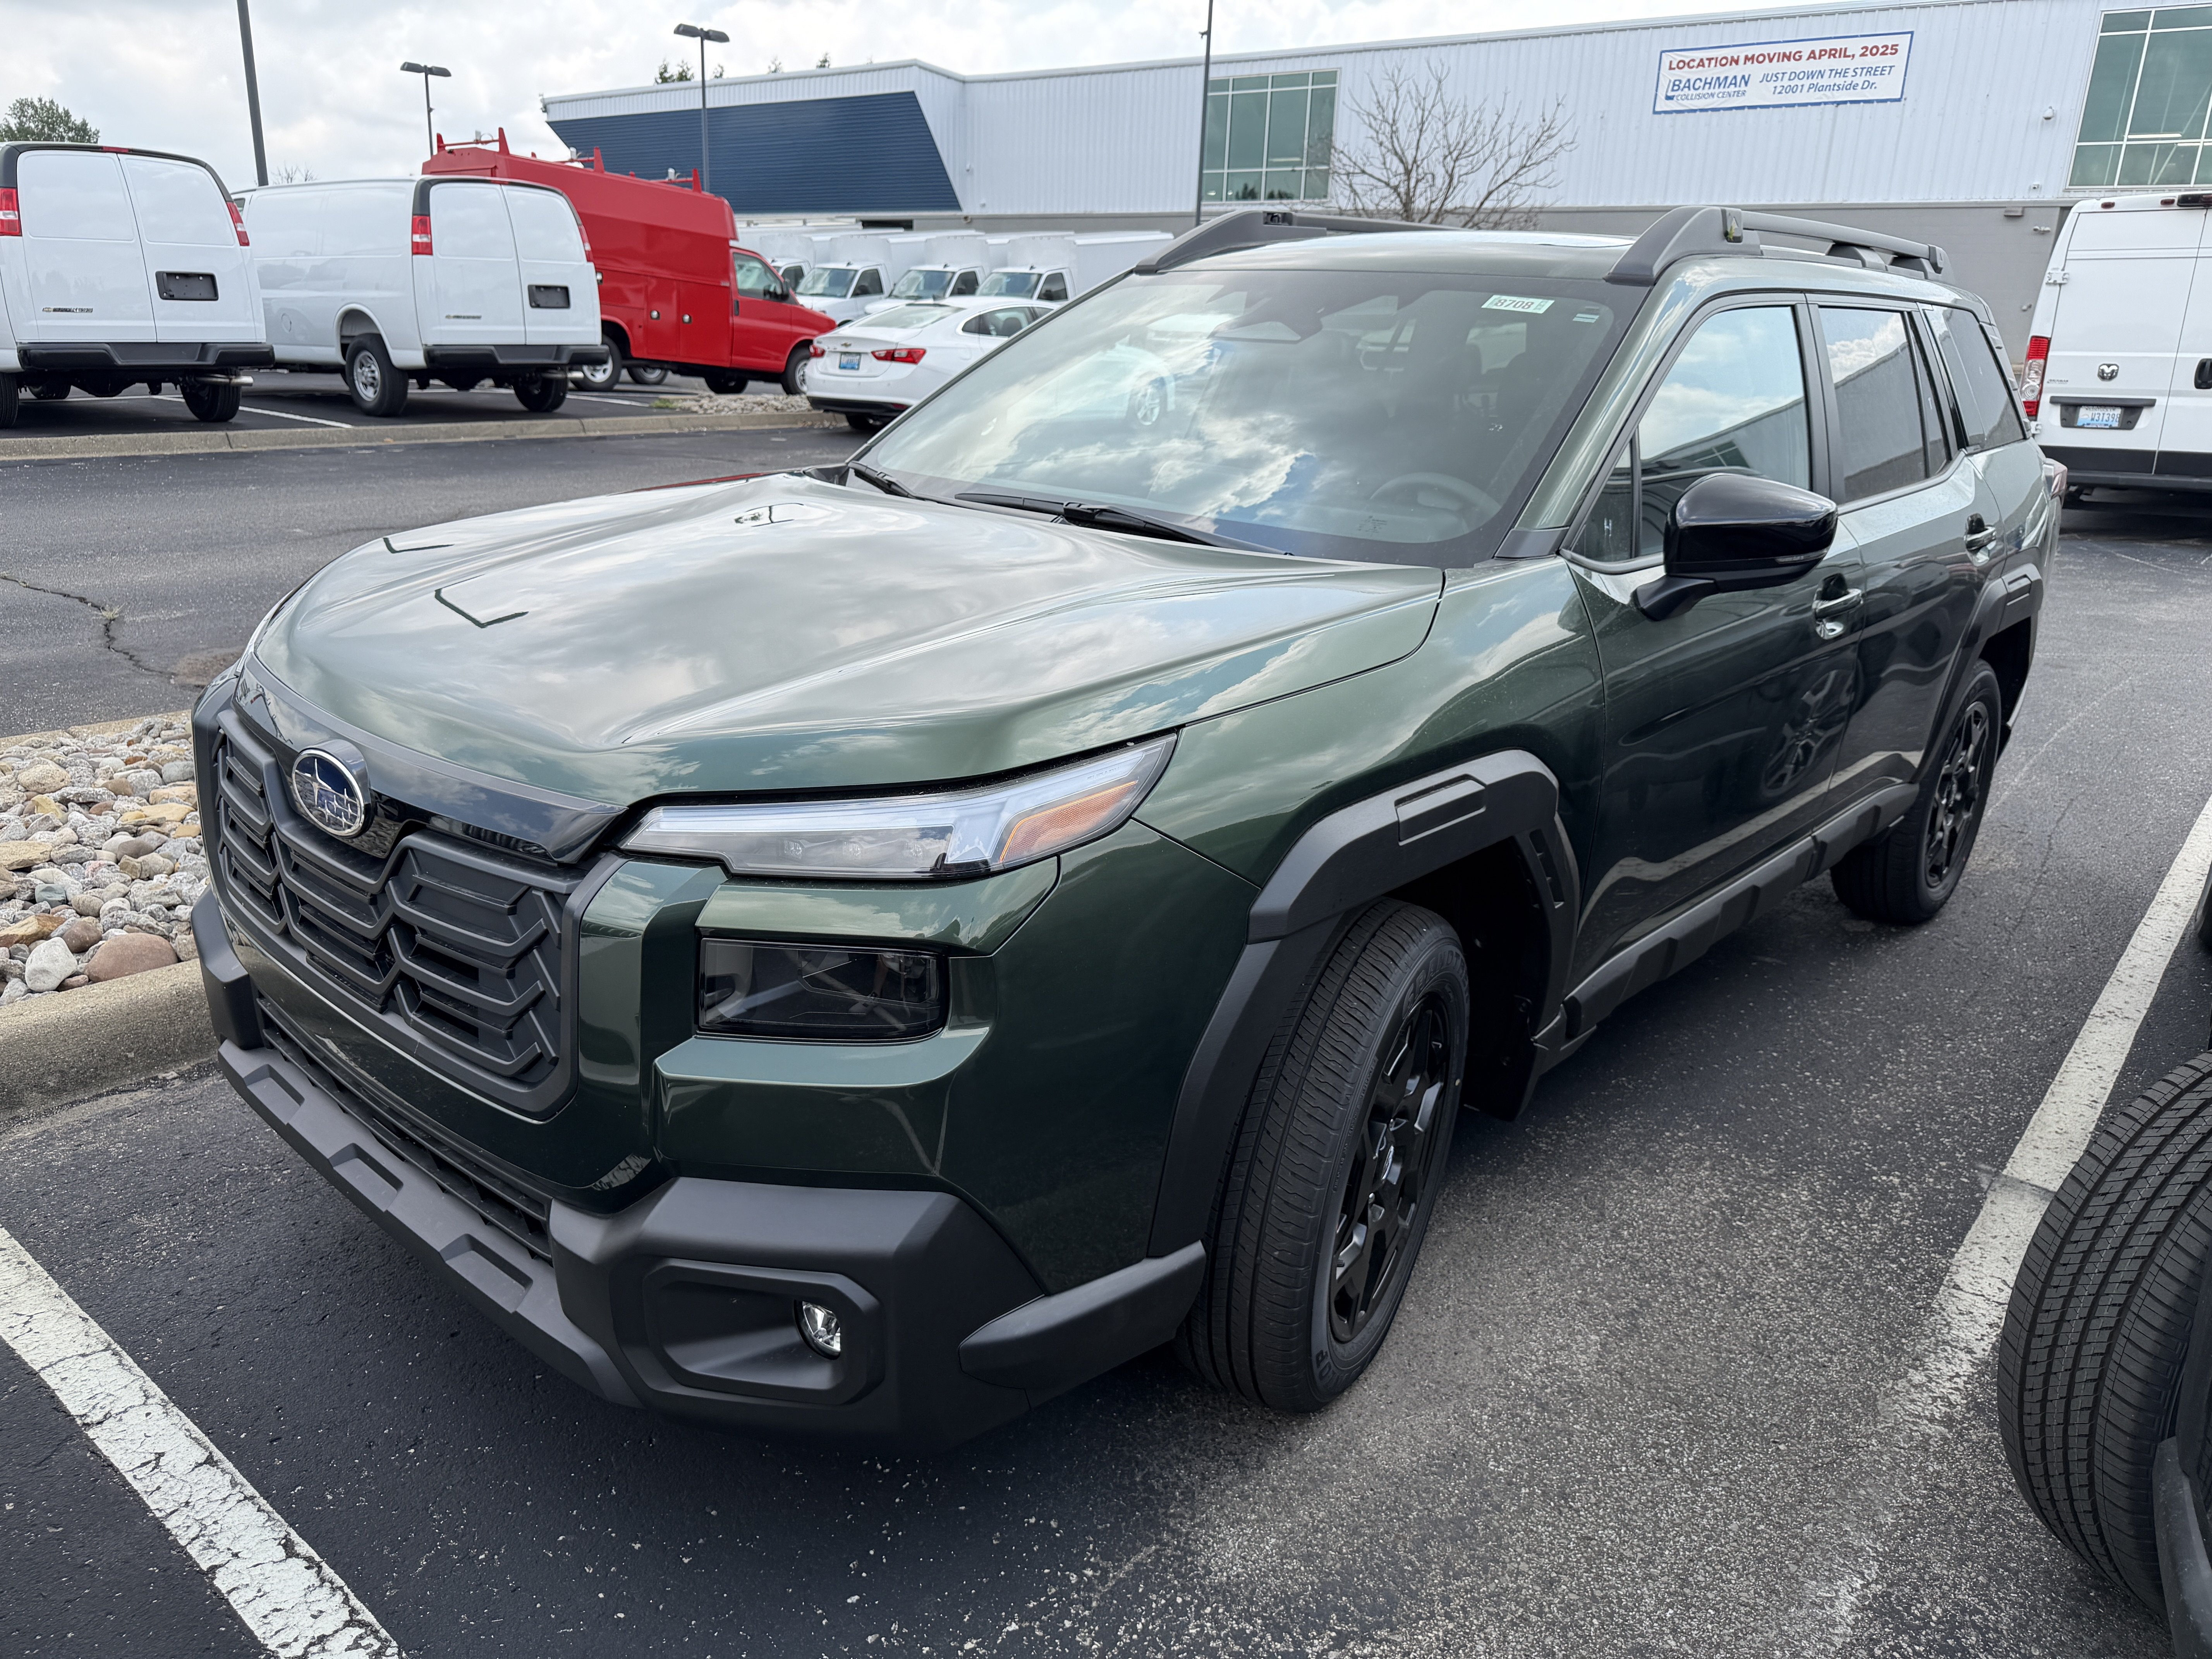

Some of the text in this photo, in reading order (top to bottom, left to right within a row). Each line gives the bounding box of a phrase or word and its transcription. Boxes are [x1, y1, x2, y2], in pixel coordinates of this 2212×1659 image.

[1668, 44, 1899, 71] LOCATION MOVING APRIL, 2025
[1759, 65, 1895, 83] JUST DOWN THE STREET
[1671, 74, 1751, 92] BACHMAN
[1772, 79, 1877, 95] 12001 Plantside Dr.
[1675, 90, 1747, 101] COLLISION CENTER
[1494, 299, 1535, 310] 8708
